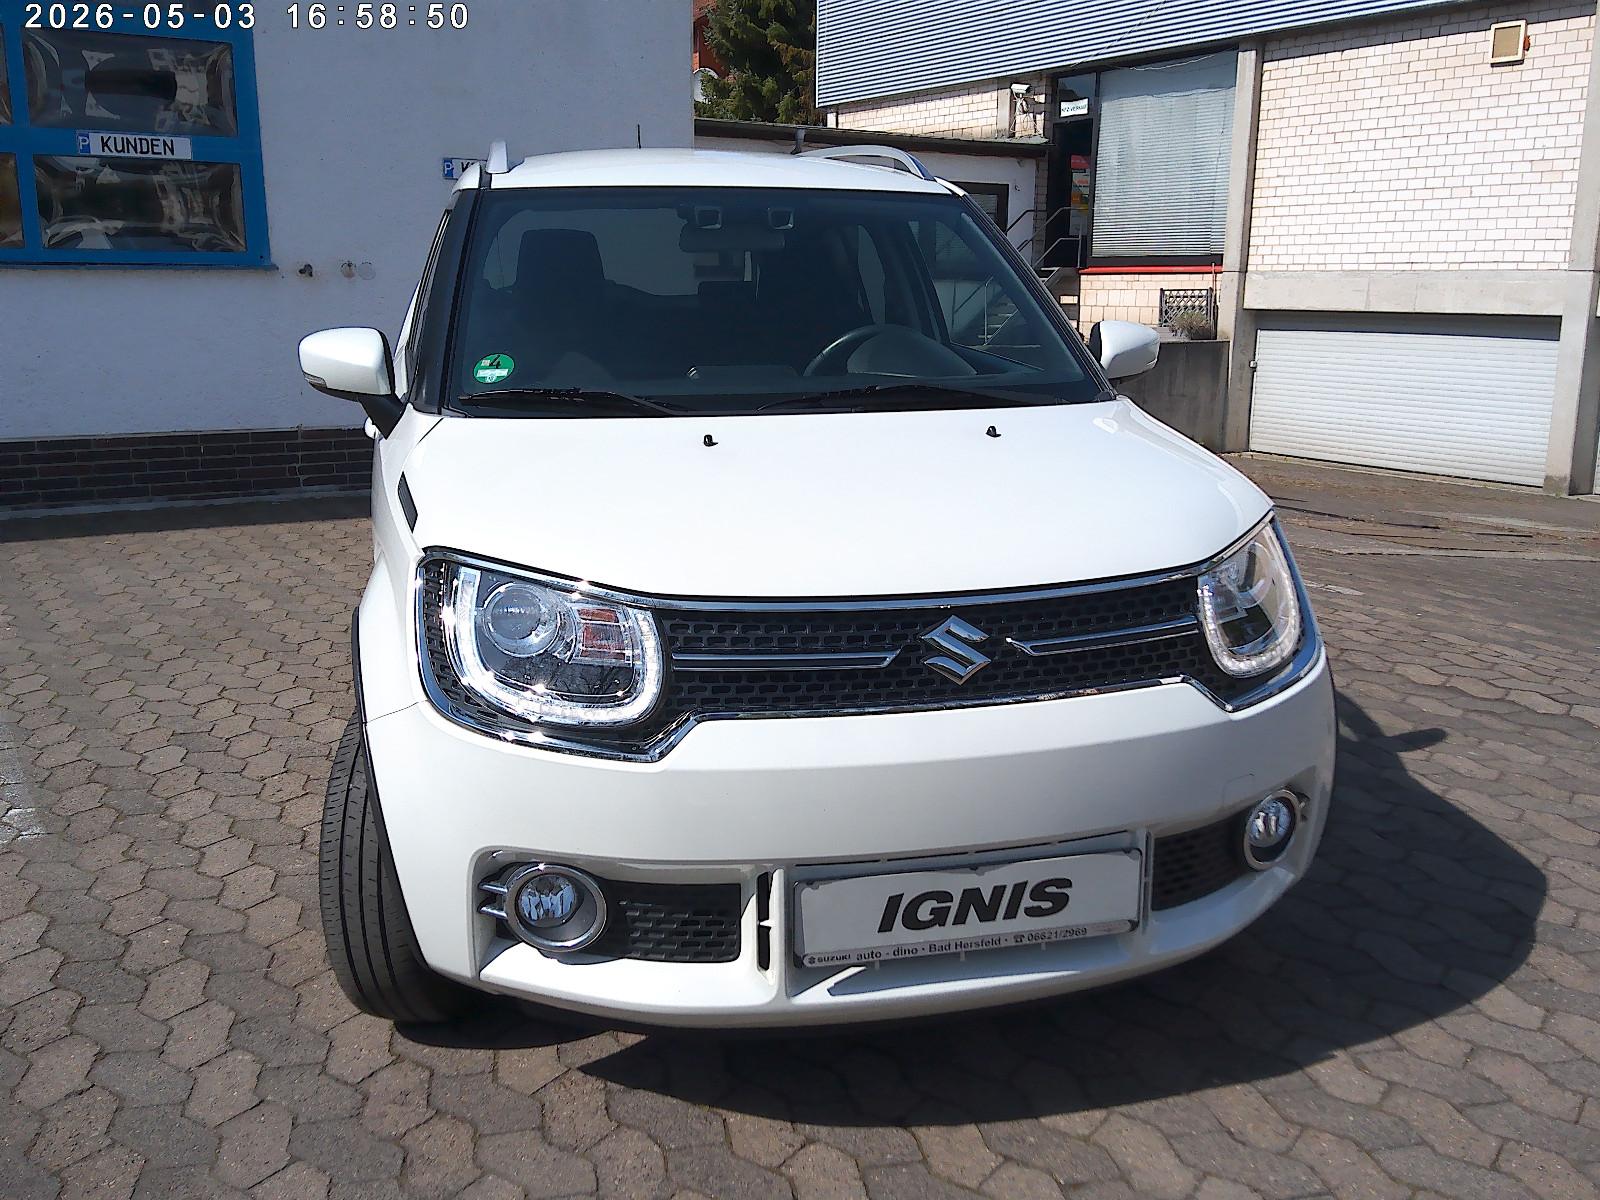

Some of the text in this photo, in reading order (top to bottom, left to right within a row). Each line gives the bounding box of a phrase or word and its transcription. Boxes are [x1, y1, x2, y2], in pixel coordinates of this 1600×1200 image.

[79, 135, 175, 156] P KUNDEN
[444, 161, 454, 175] P
[489, 354, 501, 369] 4
[877, 877, 1073, 934] IGNIS
[856, 949, 882, 961] auto
[892, 946, 918, 957] dino
[928, 941, 951, 953] Bad
[954, 936, 1001, 951] Hersfeld
